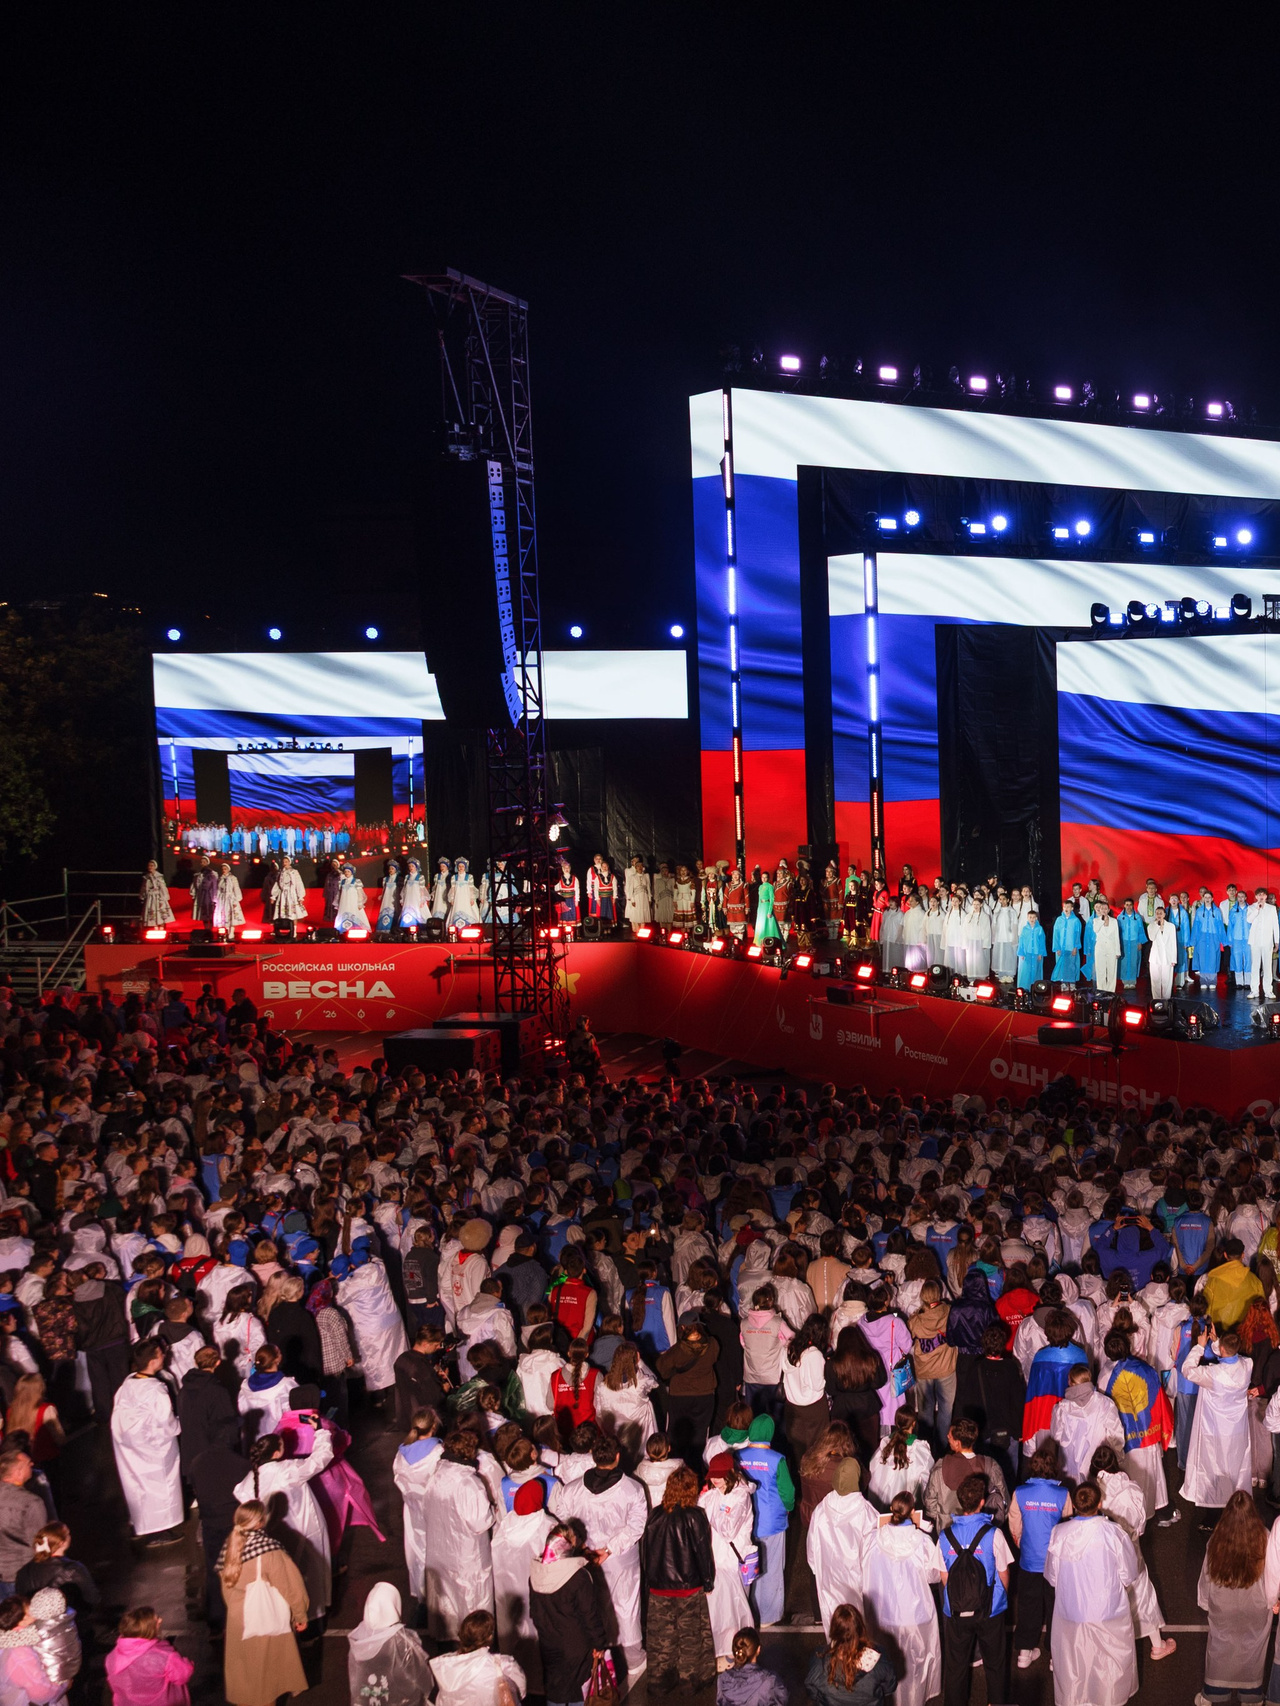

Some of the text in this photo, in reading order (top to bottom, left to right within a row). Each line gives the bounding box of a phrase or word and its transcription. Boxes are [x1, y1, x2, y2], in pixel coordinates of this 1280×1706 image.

[262, 962, 395, 972] РОССИЙСКАЯ ШКОЛЬНАЯ
[263, 980, 396, 999] ВЕСНА
[845, 1030, 881, 1048] ЭВИЛИН
[904, 1046, 948, 1065] Ростелеком
